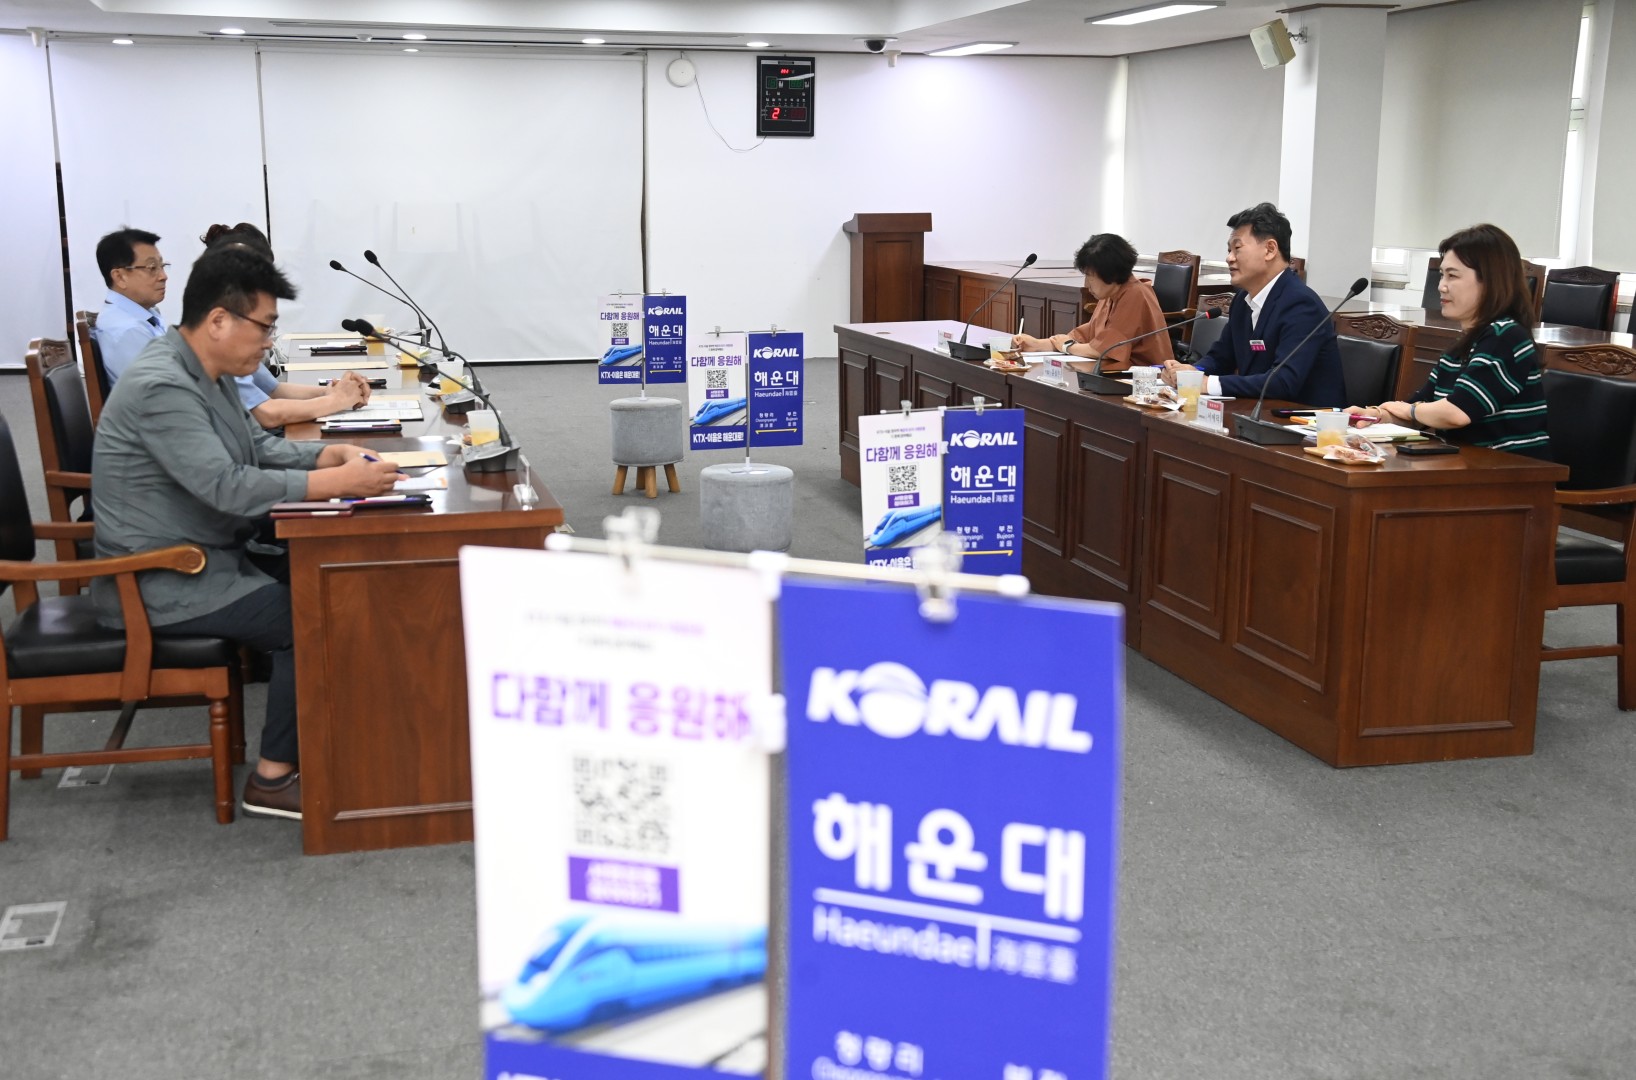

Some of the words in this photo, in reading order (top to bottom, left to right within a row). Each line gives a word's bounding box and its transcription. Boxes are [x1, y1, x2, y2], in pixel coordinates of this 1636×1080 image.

[772, 107, 780, 120] 2
[600, 312, 619, 320] 다함께
[621, 312, 640, 320] 응원해
[648, 306, 683, 316] KORAIL
[648, 325, 683, 337] 해운대
[753, 346, 800, 359] KORAIL
[691, 356, 715, 367] 다함께
[717, 355, 742, 366] 응원해
[754, 370, 799, 386] 해운대
[693, 433, 722, 443] KTX-이음은
[950, 430, 1018, 448] KORAIL
[866, 446, 901, 462] 다함께
[904, 442, 938, 460] 응원해
[950, 465, 1017, 488] 해운대
[950, 494, 992, 504] Haeundae
[491, 671, 608, 731] 다함께
[628, 681, 752, 741] 응원해
[806, 661, 1093, 753] KORAIL
[812, 792, 1086, 922] 해운대
[812, 904, 977, 968] Haeundae
